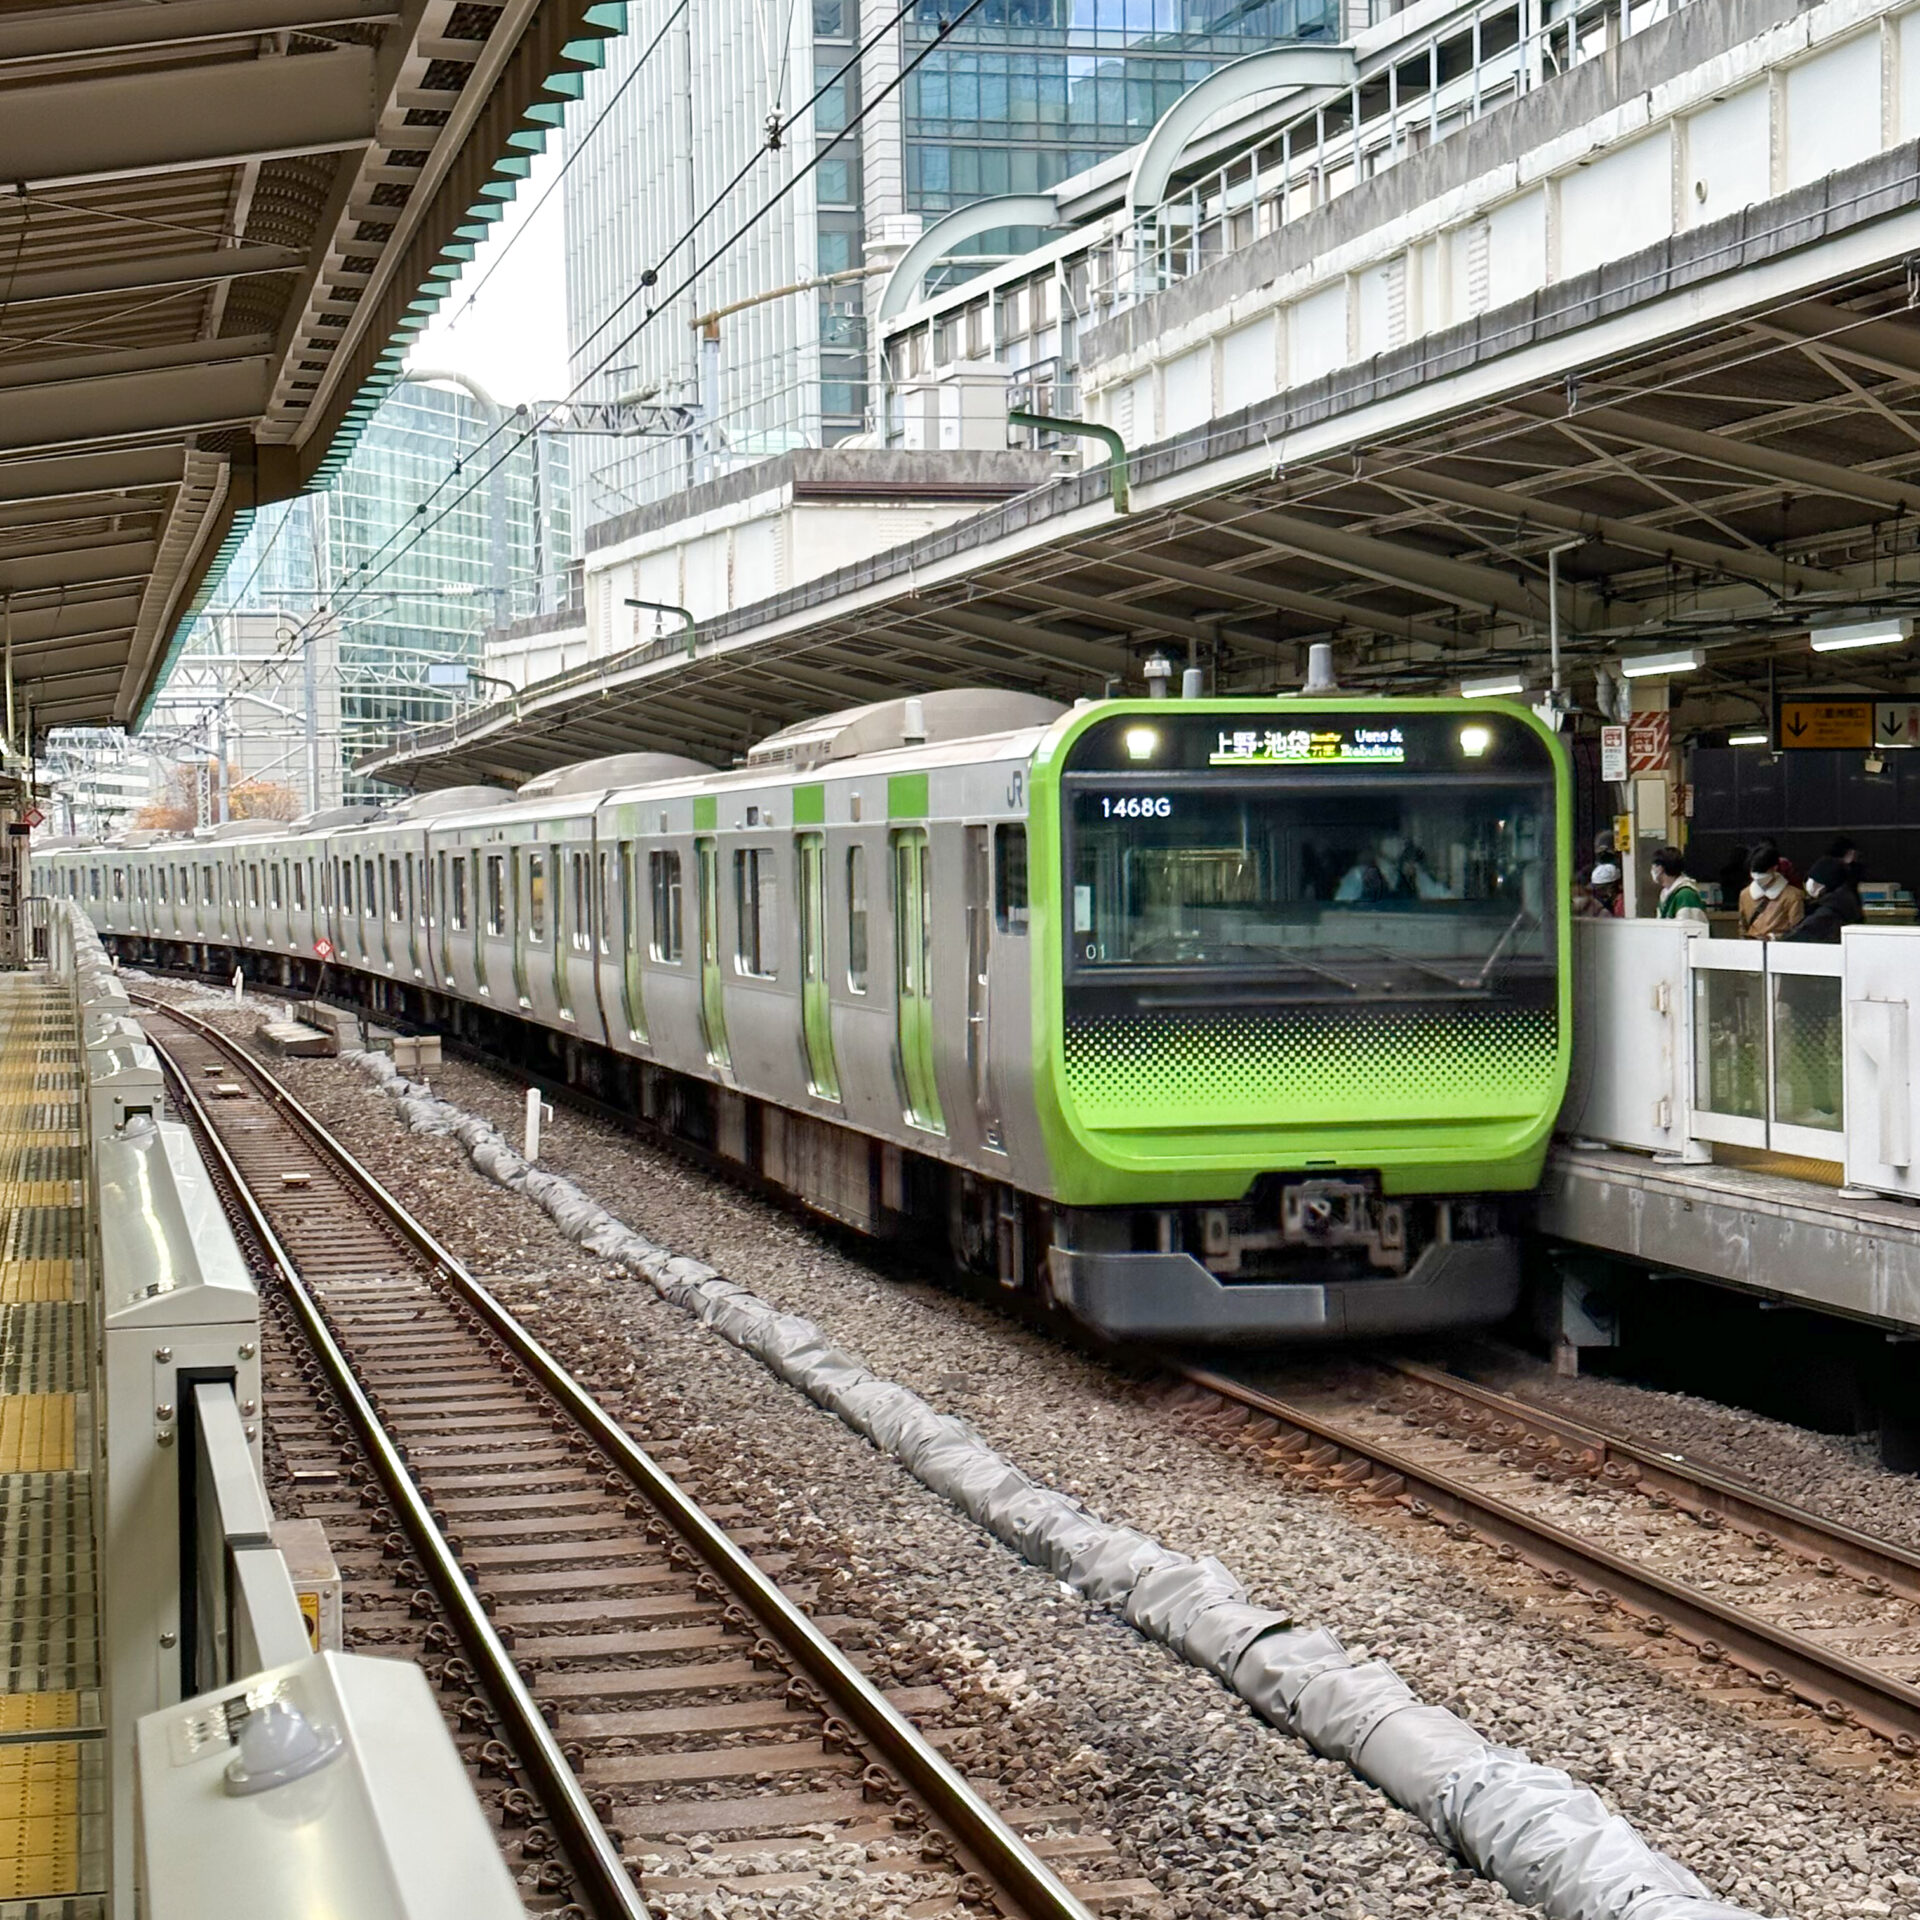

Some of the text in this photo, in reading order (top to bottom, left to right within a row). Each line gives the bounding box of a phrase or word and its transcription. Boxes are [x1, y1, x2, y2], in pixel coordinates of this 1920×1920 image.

[1355, 729, 1388, 742] Ueno
[1389, 728, 1404, 742] &
[1340, 744, 1404, 757] Ikebukuro
[1006, 770, 1023, 808] JR
[1101, 797, 1172, 818] 1468G
[1085, 944, 1106, 960] 01
